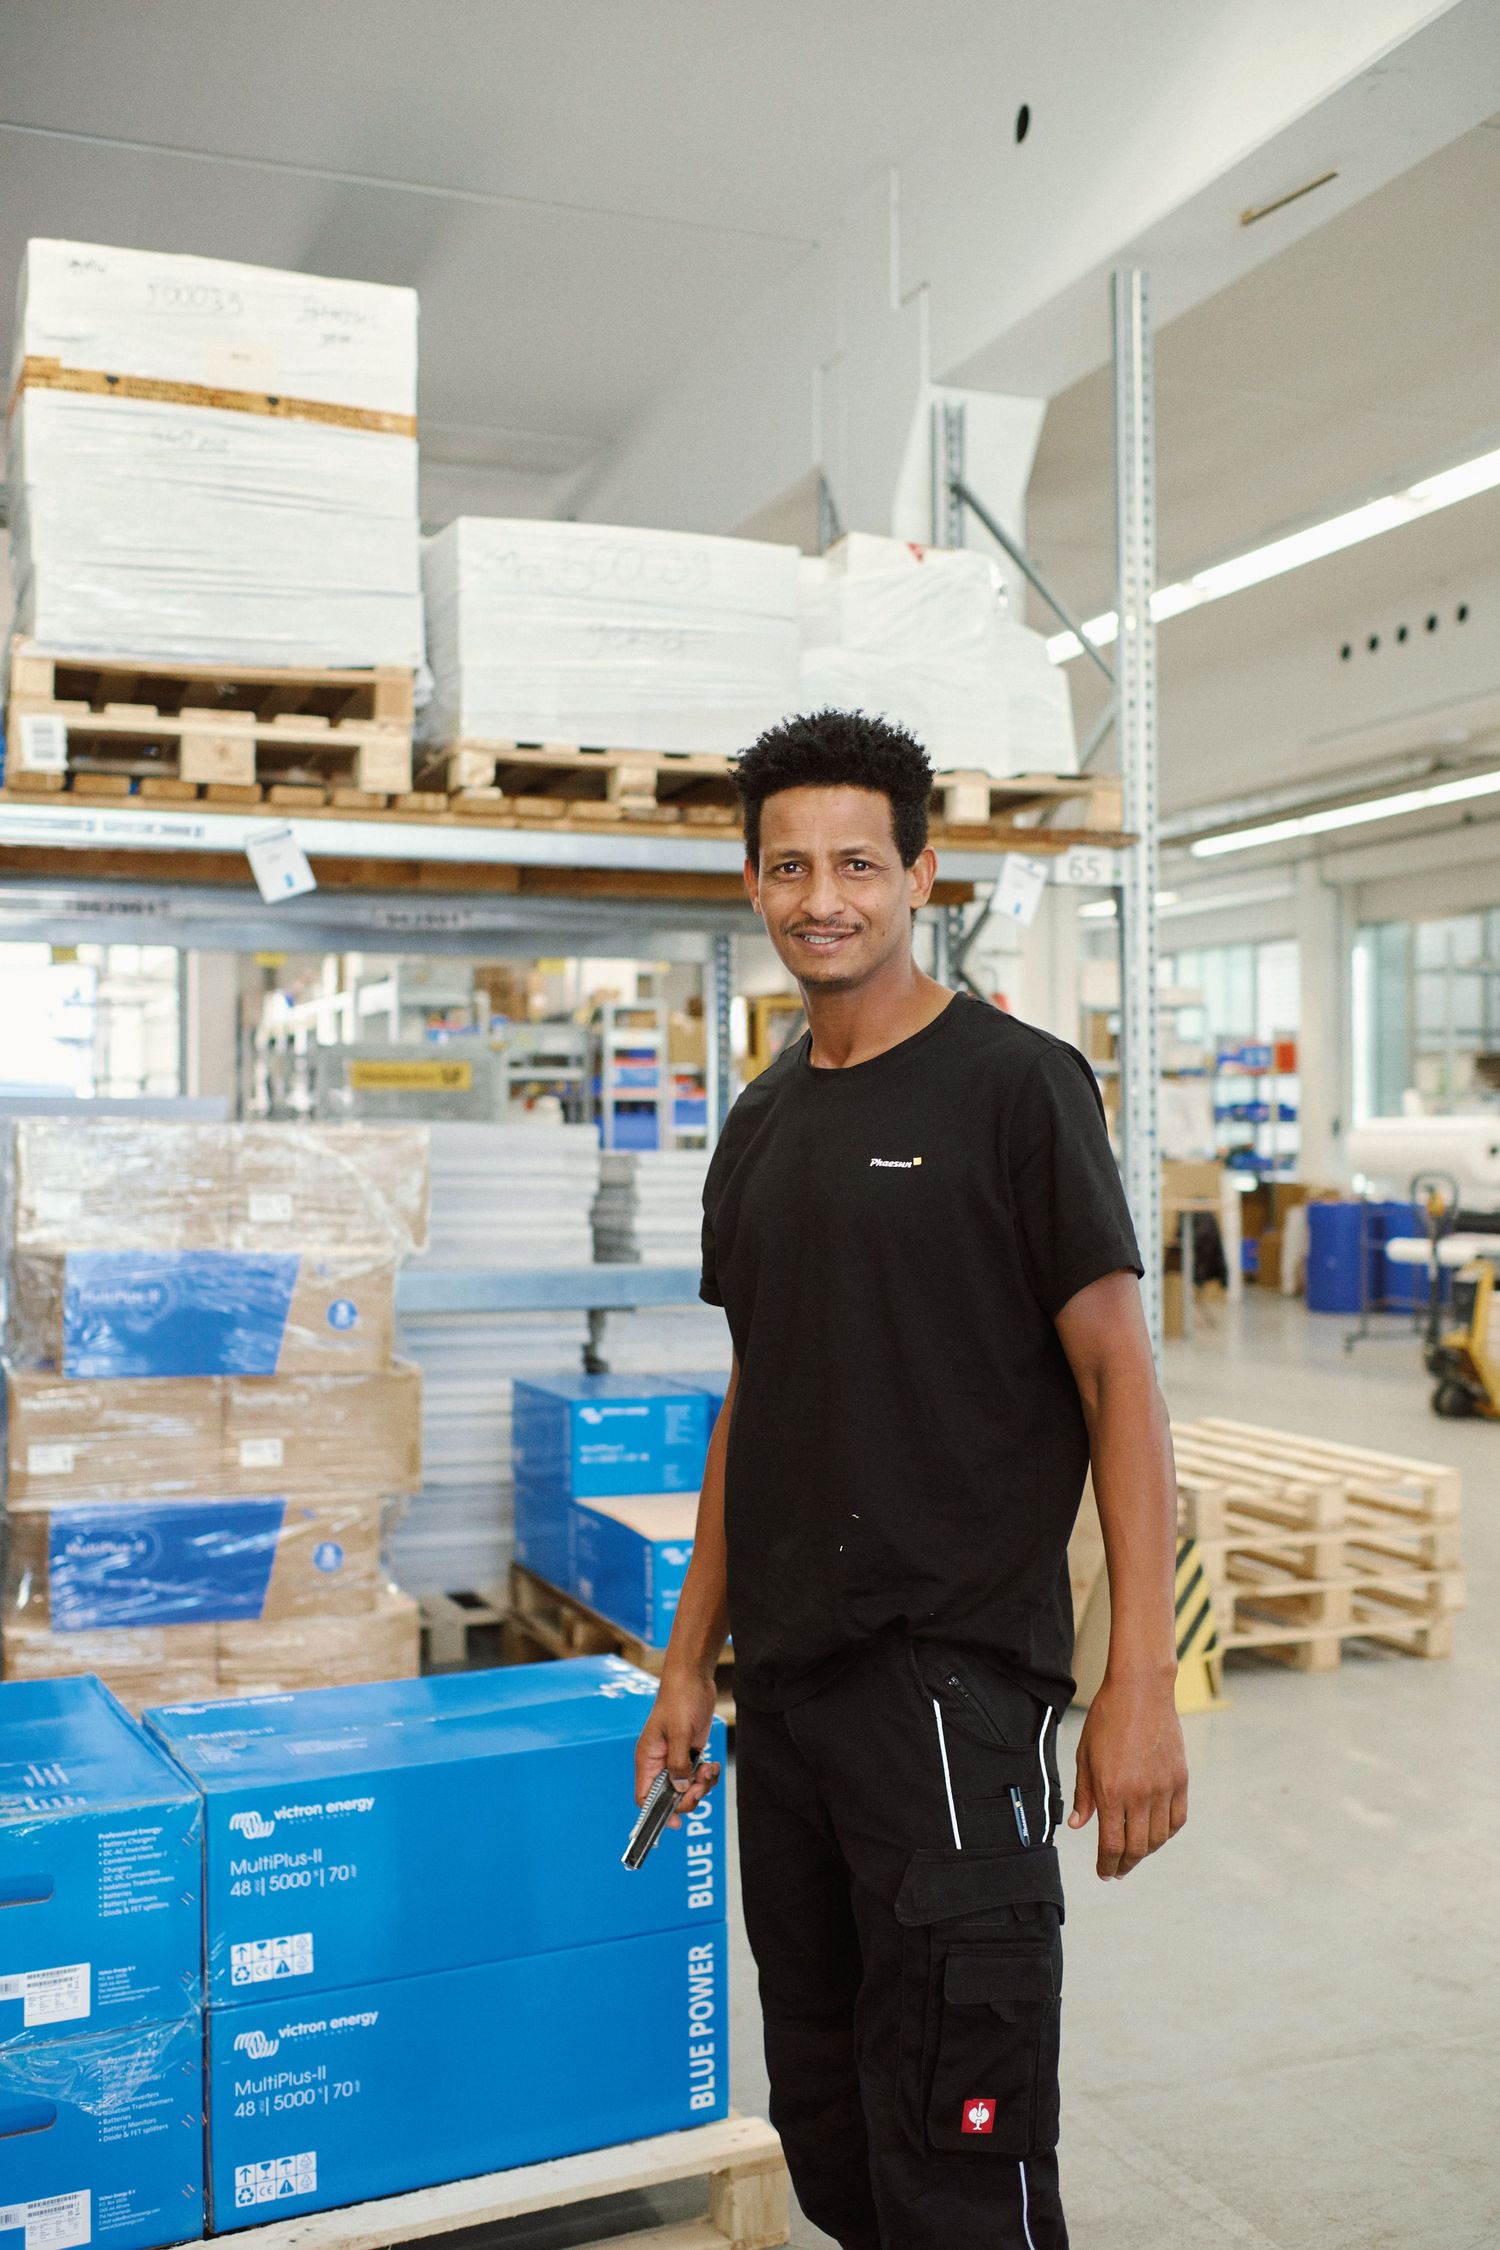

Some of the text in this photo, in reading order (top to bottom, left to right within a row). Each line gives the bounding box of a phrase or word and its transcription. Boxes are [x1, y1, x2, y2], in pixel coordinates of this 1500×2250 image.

[1068, 856, 1100, 880] 65
[869, 1158, 913, 1169] Phaesun
[273, 1797, 375, 1820] victron energy
[230, 1848, 322, 1877] MultiPlus-II
[687, 1842, 714, 1909] BLUE
[230, 1880, 251, 1897] 48
[269, 1870, 312, 1891] 5000
[328, 1864, 350, 1883] 70
[688, 1942, 715, 2038] POWER
[278, 2010, 379, 2038] victron energy
[234, 2065, 326, 2097] MultiPlus-II
[689, 2042, 716, 2111] BLUE
[234, 2100, 256, 2118] 48
[273, 2088, 315, 2111] 5000
[333, 2081, 353, 2099] 70
[103, 2114, 132, 2125] Batteries
[103, 2117, 157, 2134] Battery Monitors
[103, 2133, 123, 2143] Diode
